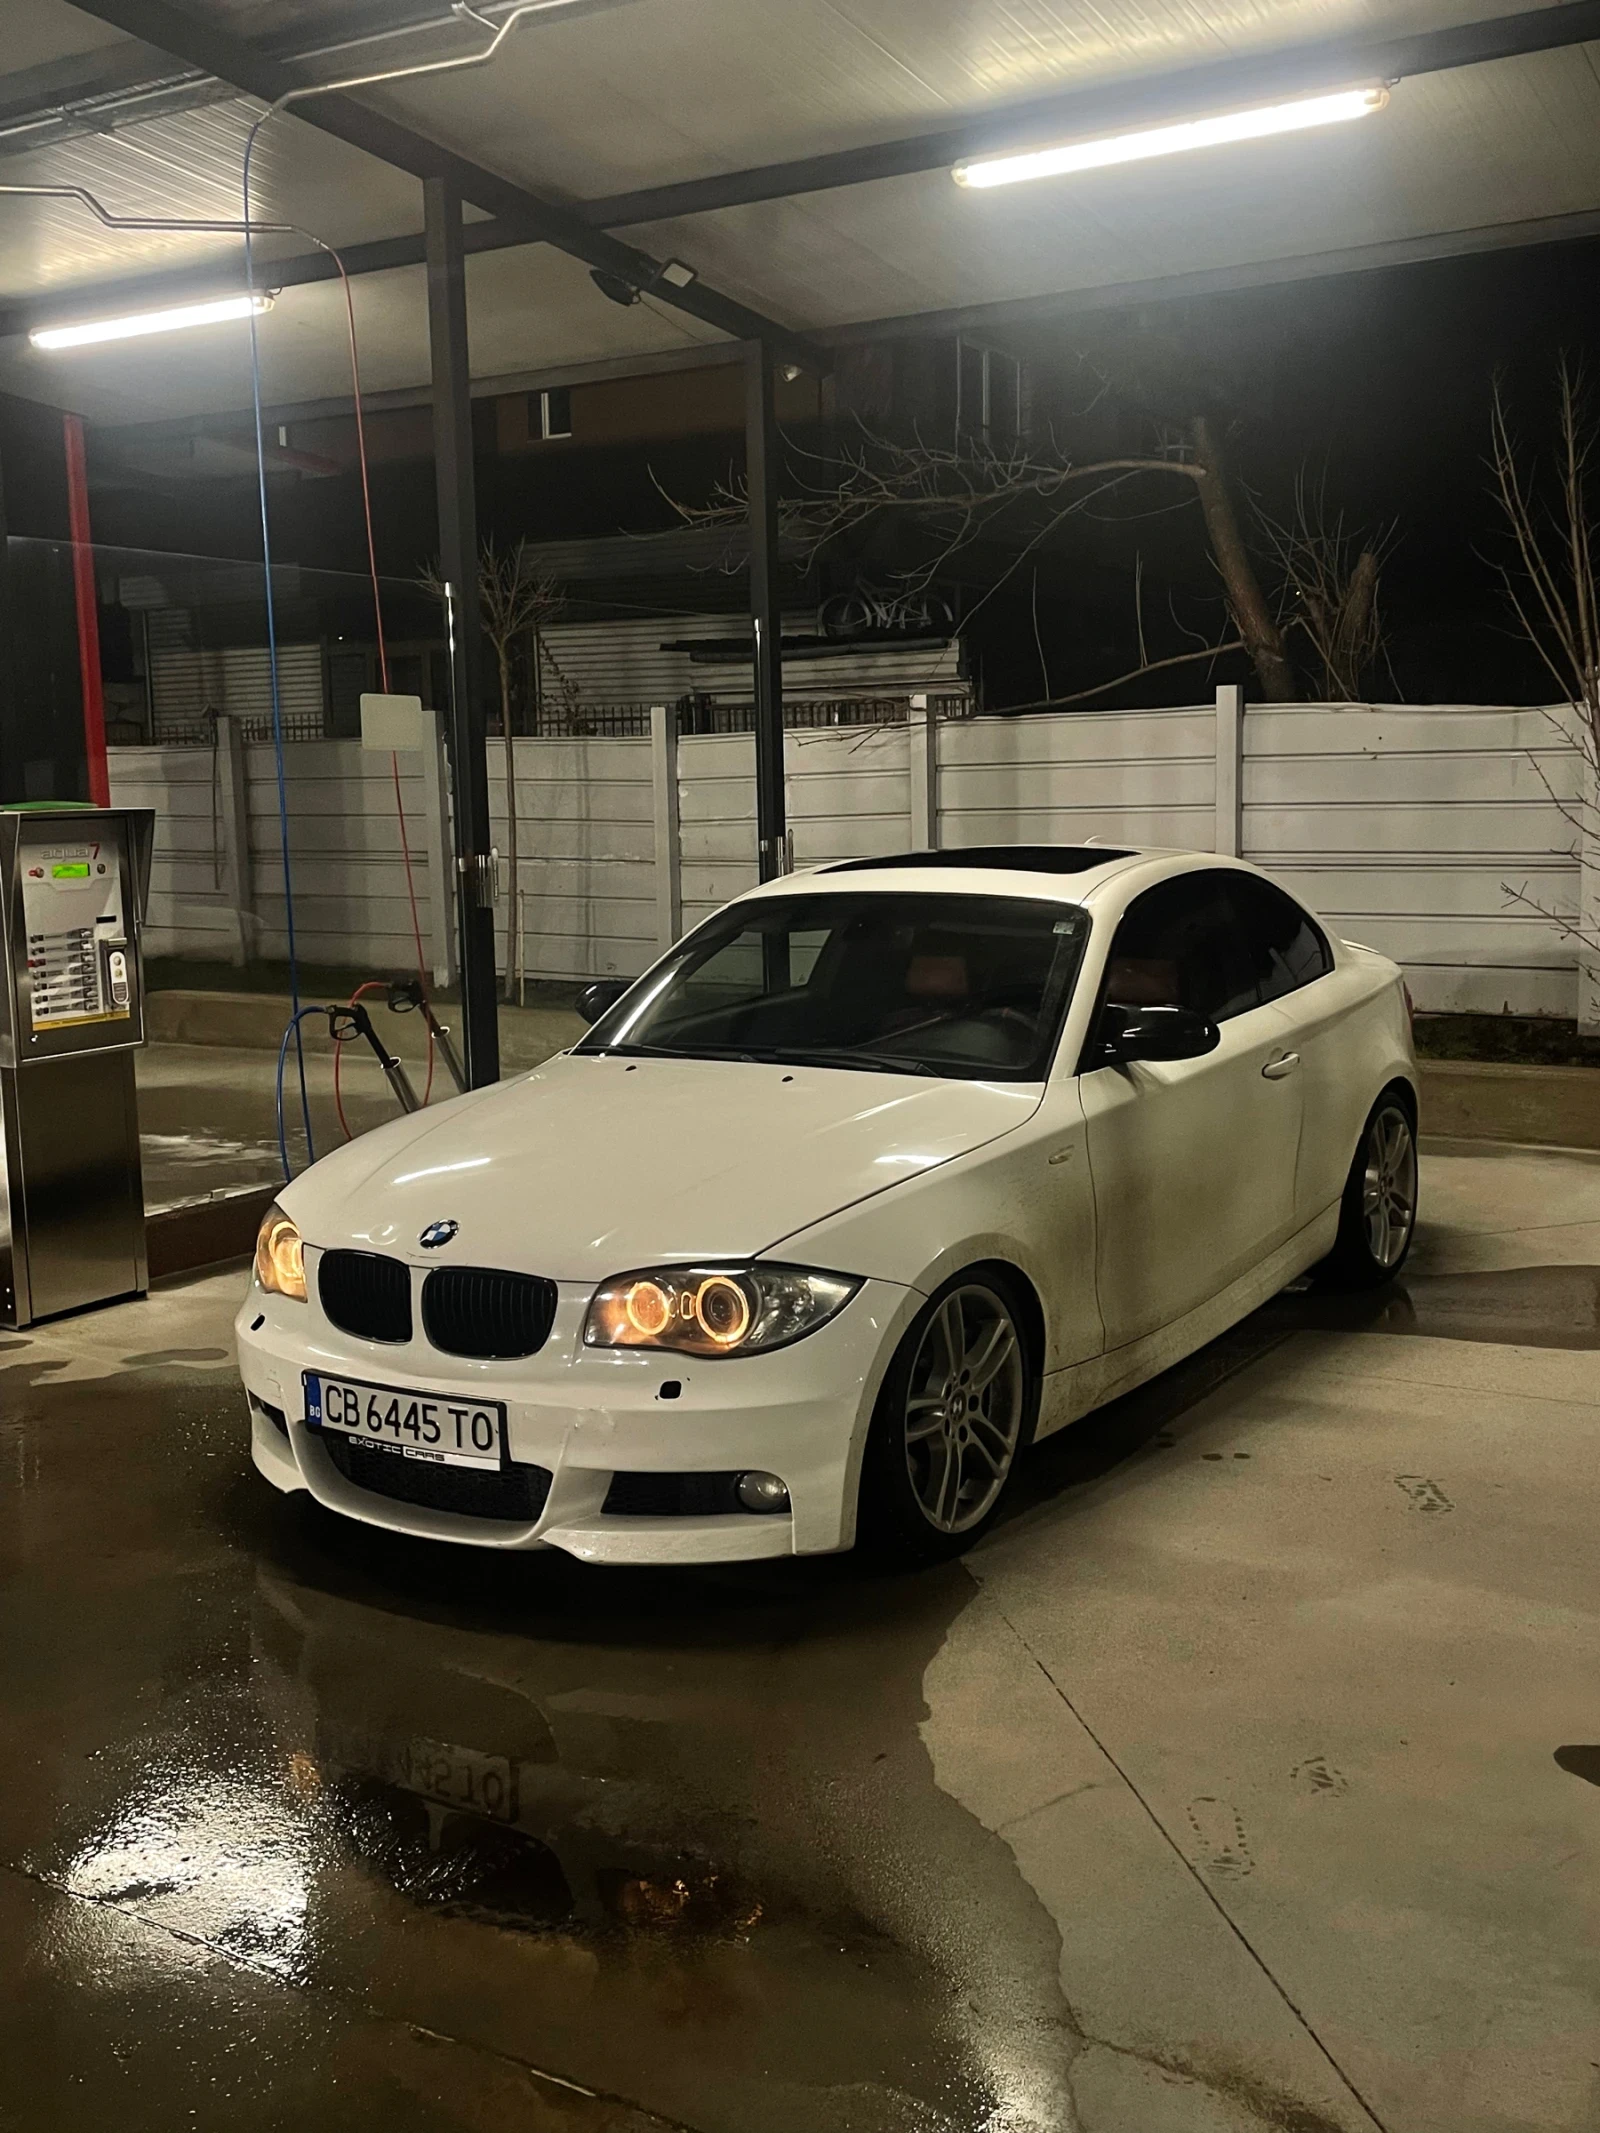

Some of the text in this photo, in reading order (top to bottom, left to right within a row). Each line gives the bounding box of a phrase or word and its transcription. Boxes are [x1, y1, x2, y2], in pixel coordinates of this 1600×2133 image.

[309, 1404, 321, 1418] BG
[325, 1385, 360, 1427] CB
[367, 1394, 441, 1444] 6445
[405, 1449, 445, 1461] CARS
